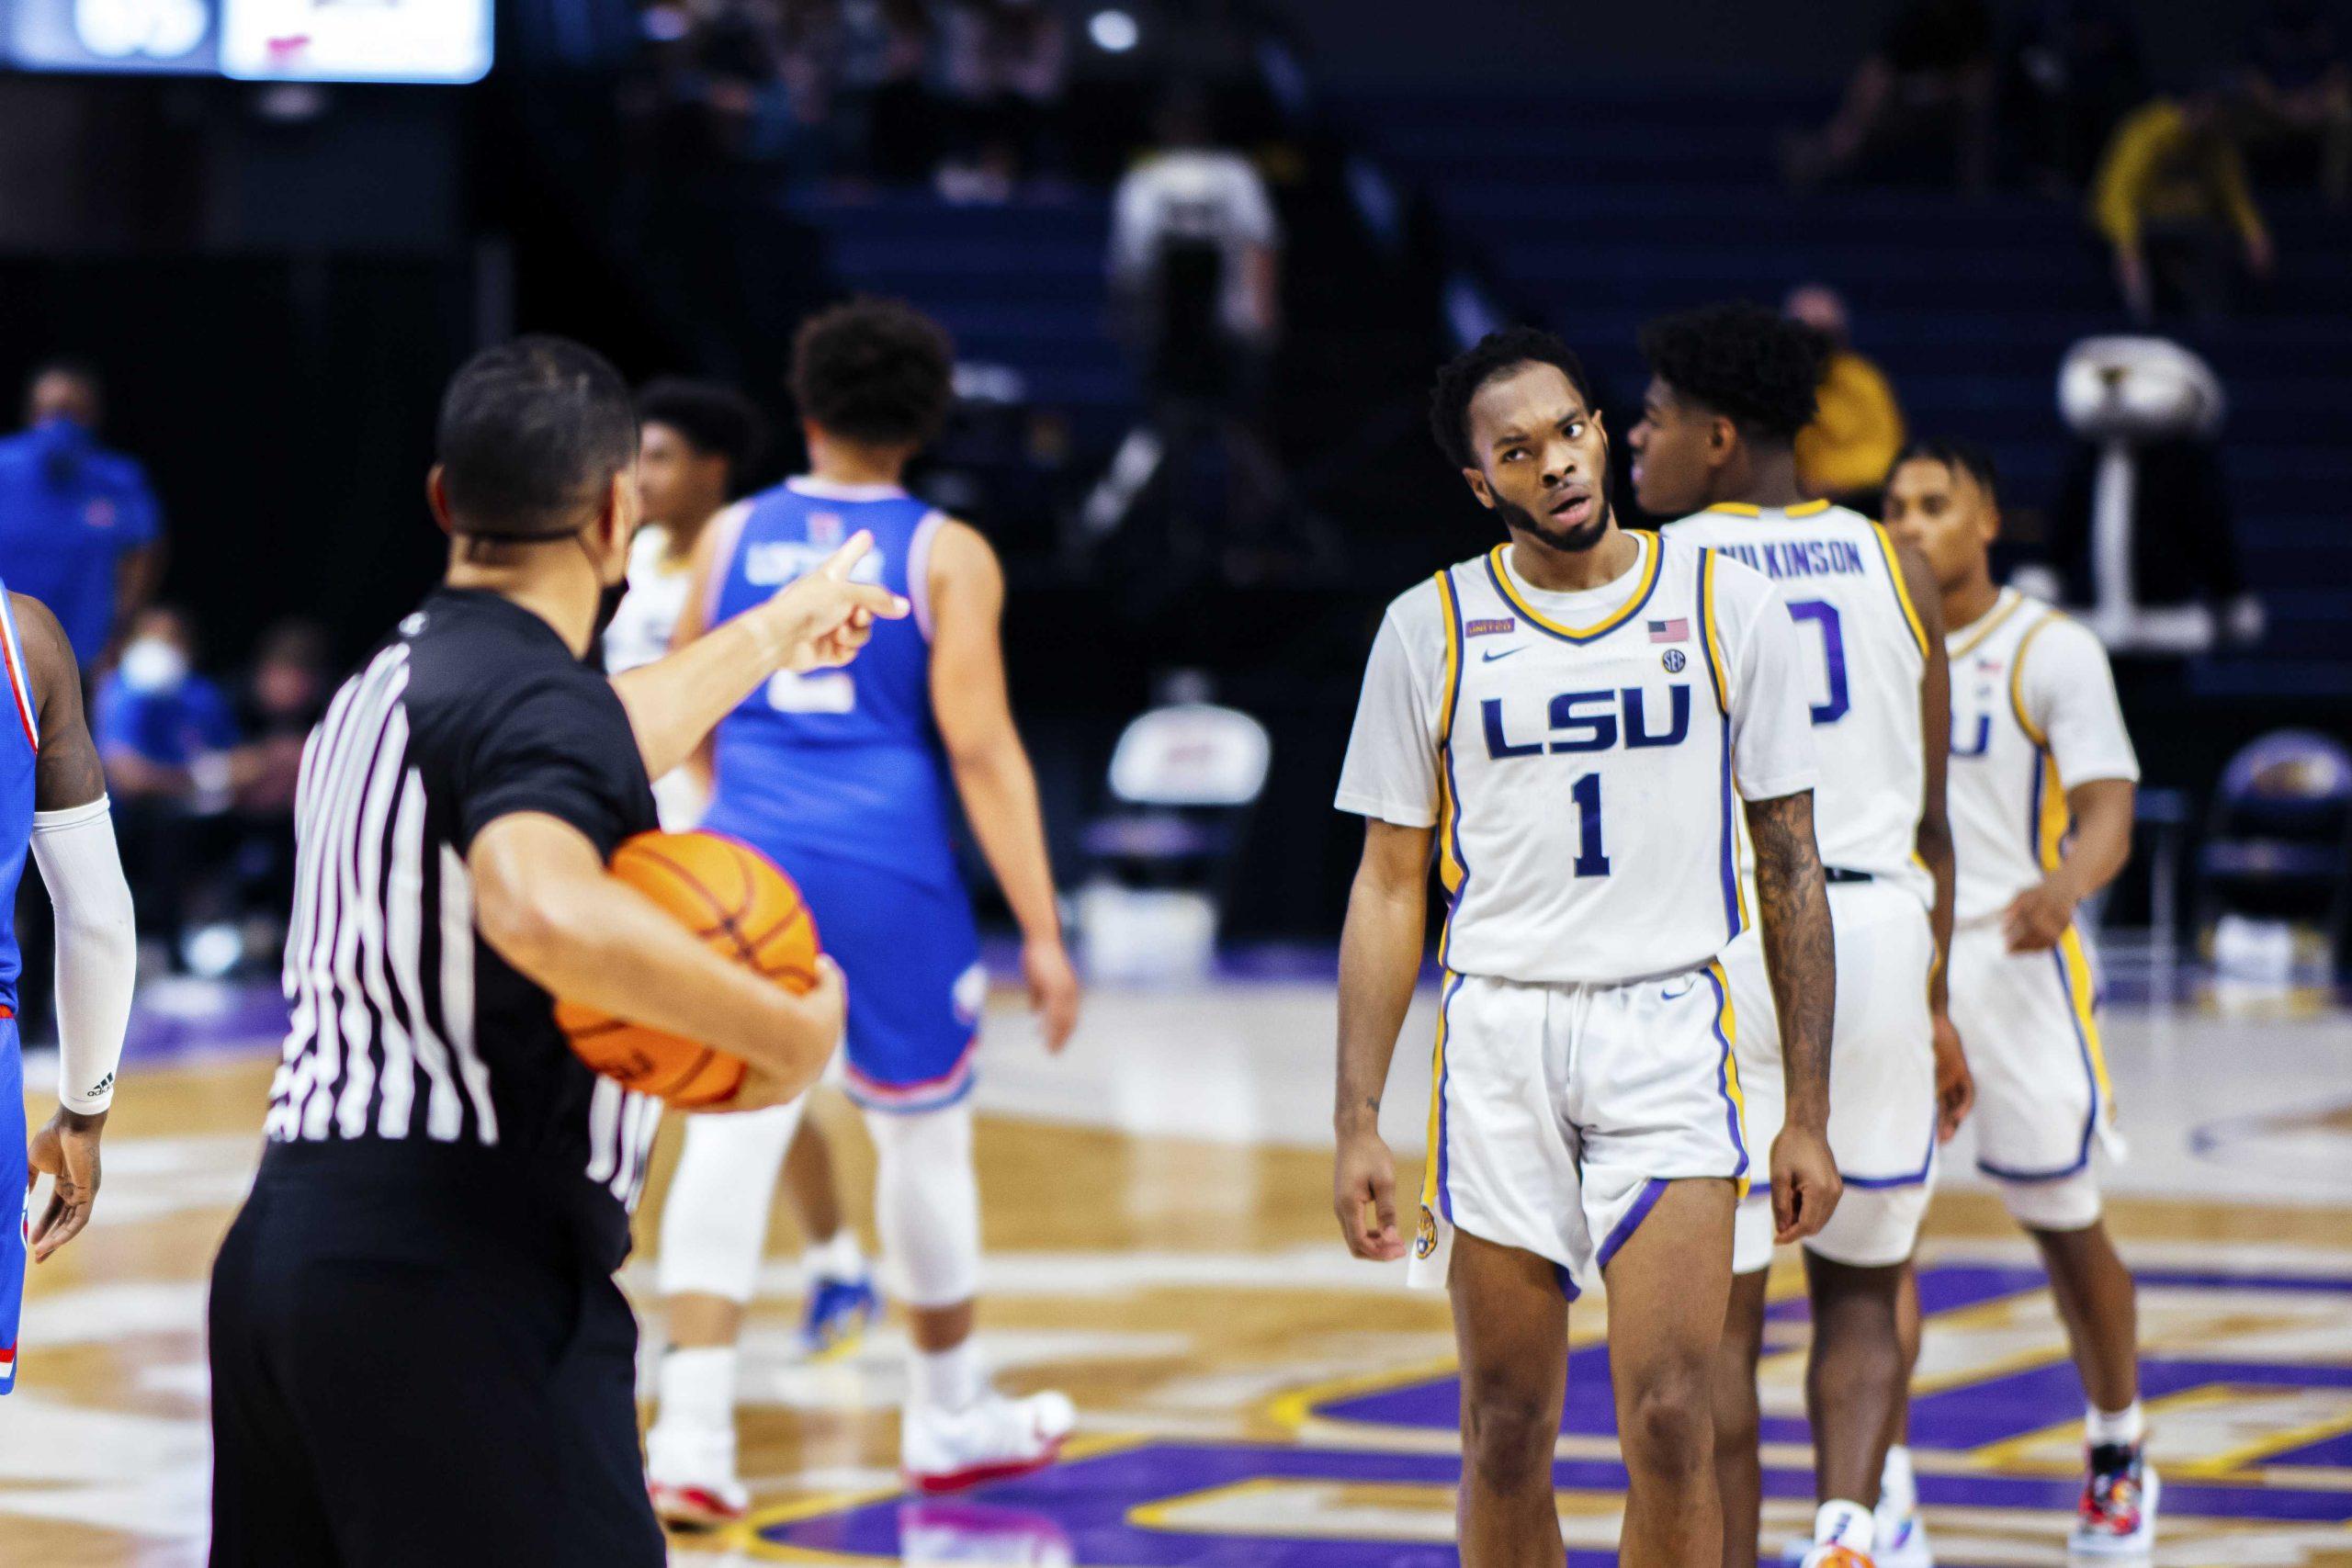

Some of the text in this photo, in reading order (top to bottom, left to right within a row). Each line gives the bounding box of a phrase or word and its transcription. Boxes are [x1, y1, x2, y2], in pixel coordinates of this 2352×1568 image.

[1663, 649, 1684, 671] SEC
[1480, 684, 1690, 761] LSU
[1570, 773, 1611, 877] 1
